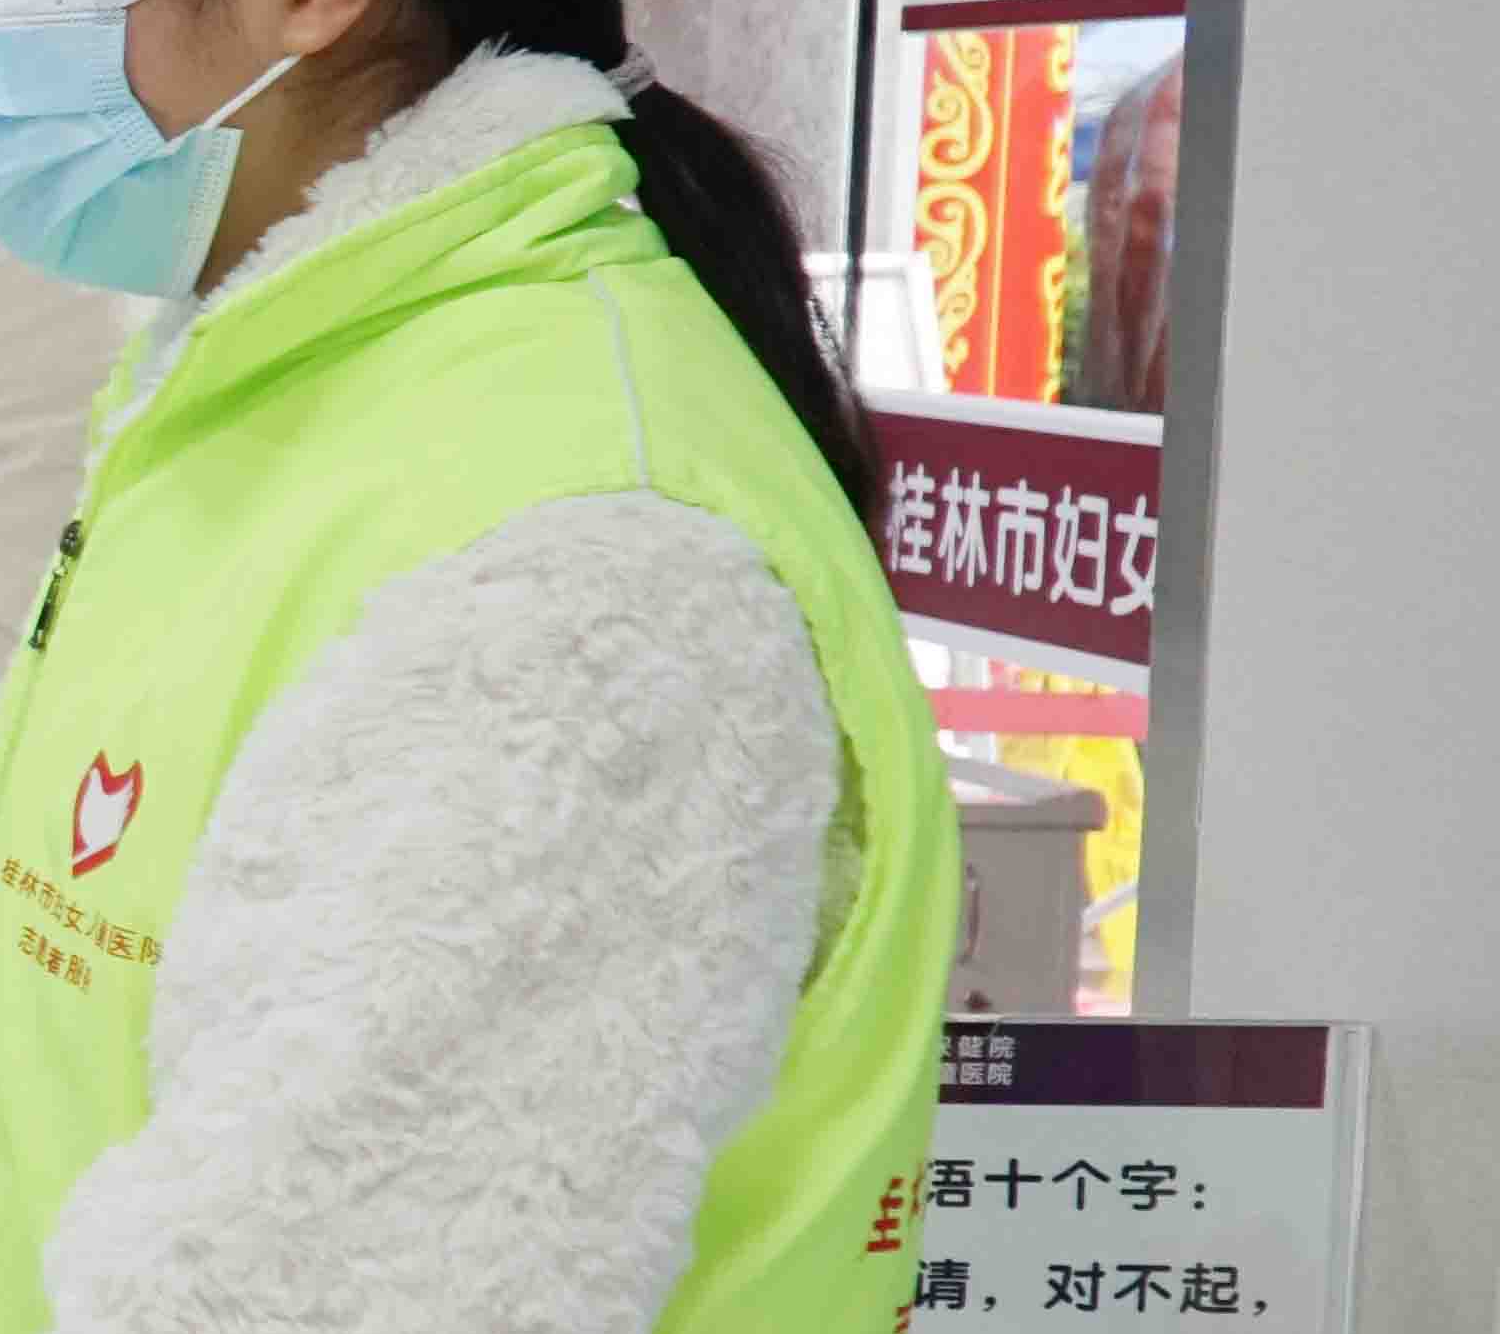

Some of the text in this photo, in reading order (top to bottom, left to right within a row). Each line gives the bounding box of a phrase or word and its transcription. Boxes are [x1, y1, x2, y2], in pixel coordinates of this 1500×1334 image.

[885, 460, 1159, 616] 桂林市妇女
